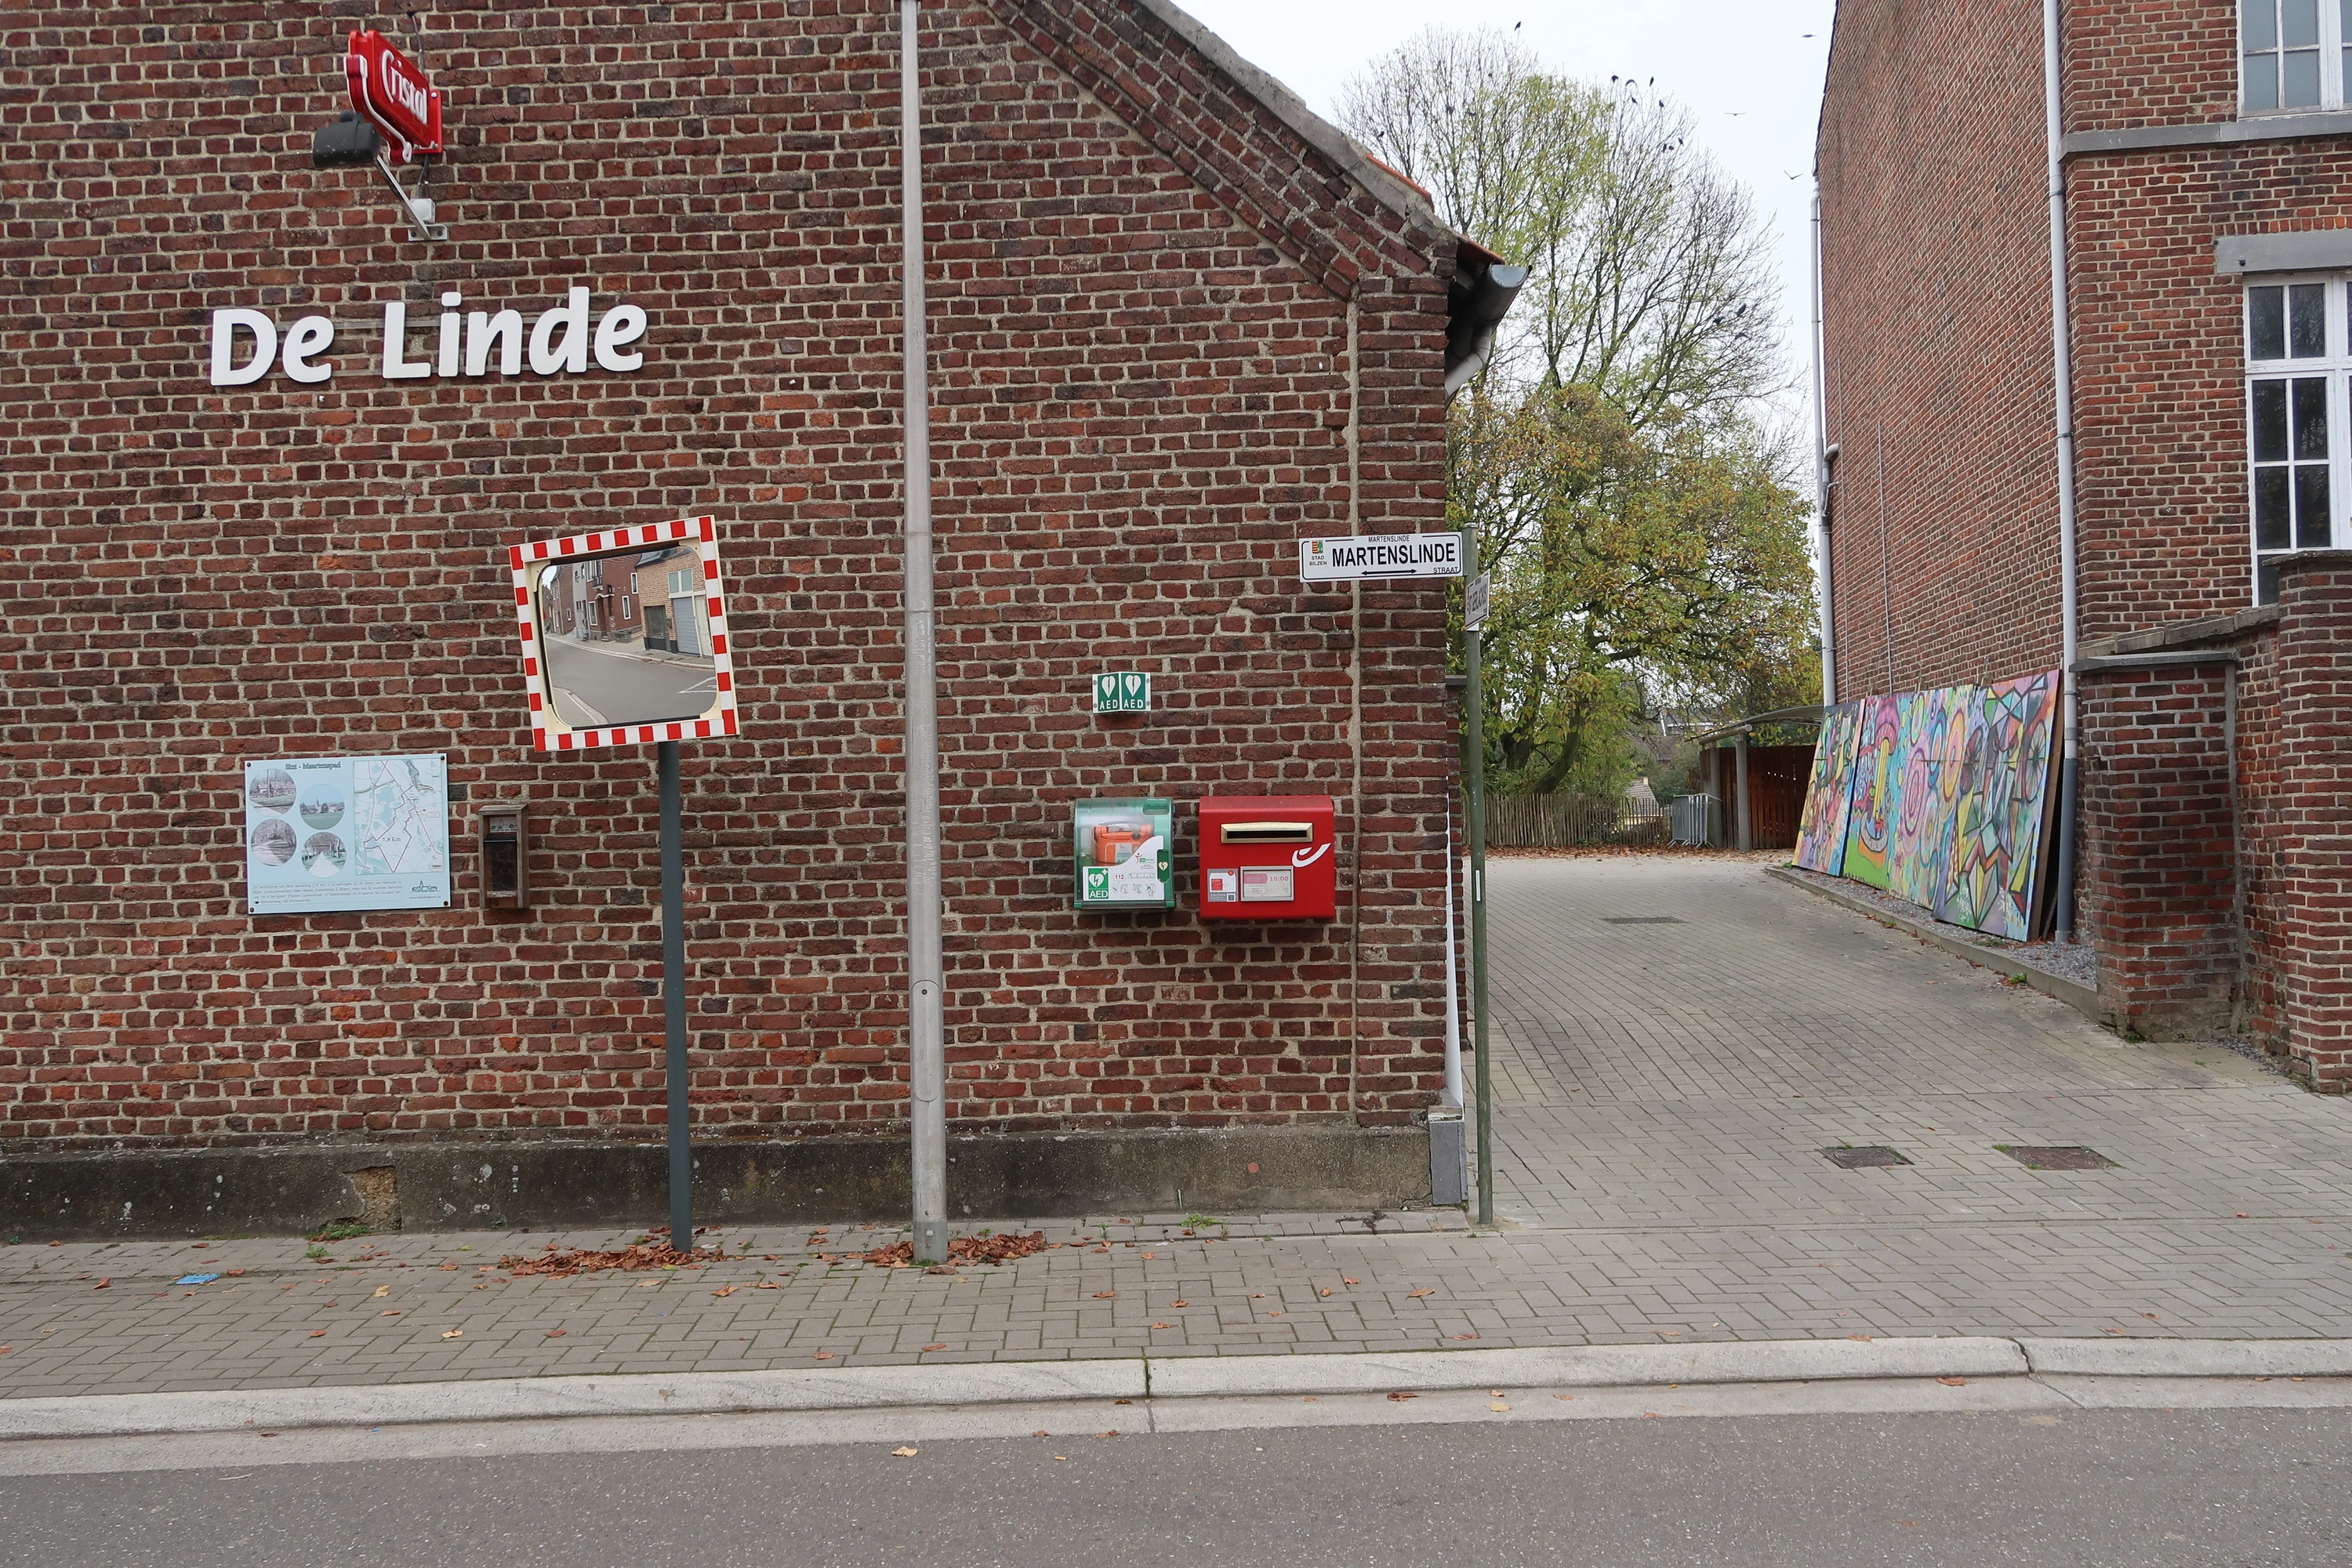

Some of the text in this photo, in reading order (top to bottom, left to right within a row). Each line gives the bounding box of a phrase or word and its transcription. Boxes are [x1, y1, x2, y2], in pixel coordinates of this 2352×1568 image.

[382, 49, 428, 125] Cristal
[210, 285, 647, 386] De Linde
[1333, 543, 1456, 567] MARTENSLINDE
[1099, 699, 1118, 710] AED
[1123, 699, 1144, 709] AED
[1089, 890, 1109, 898] AED
